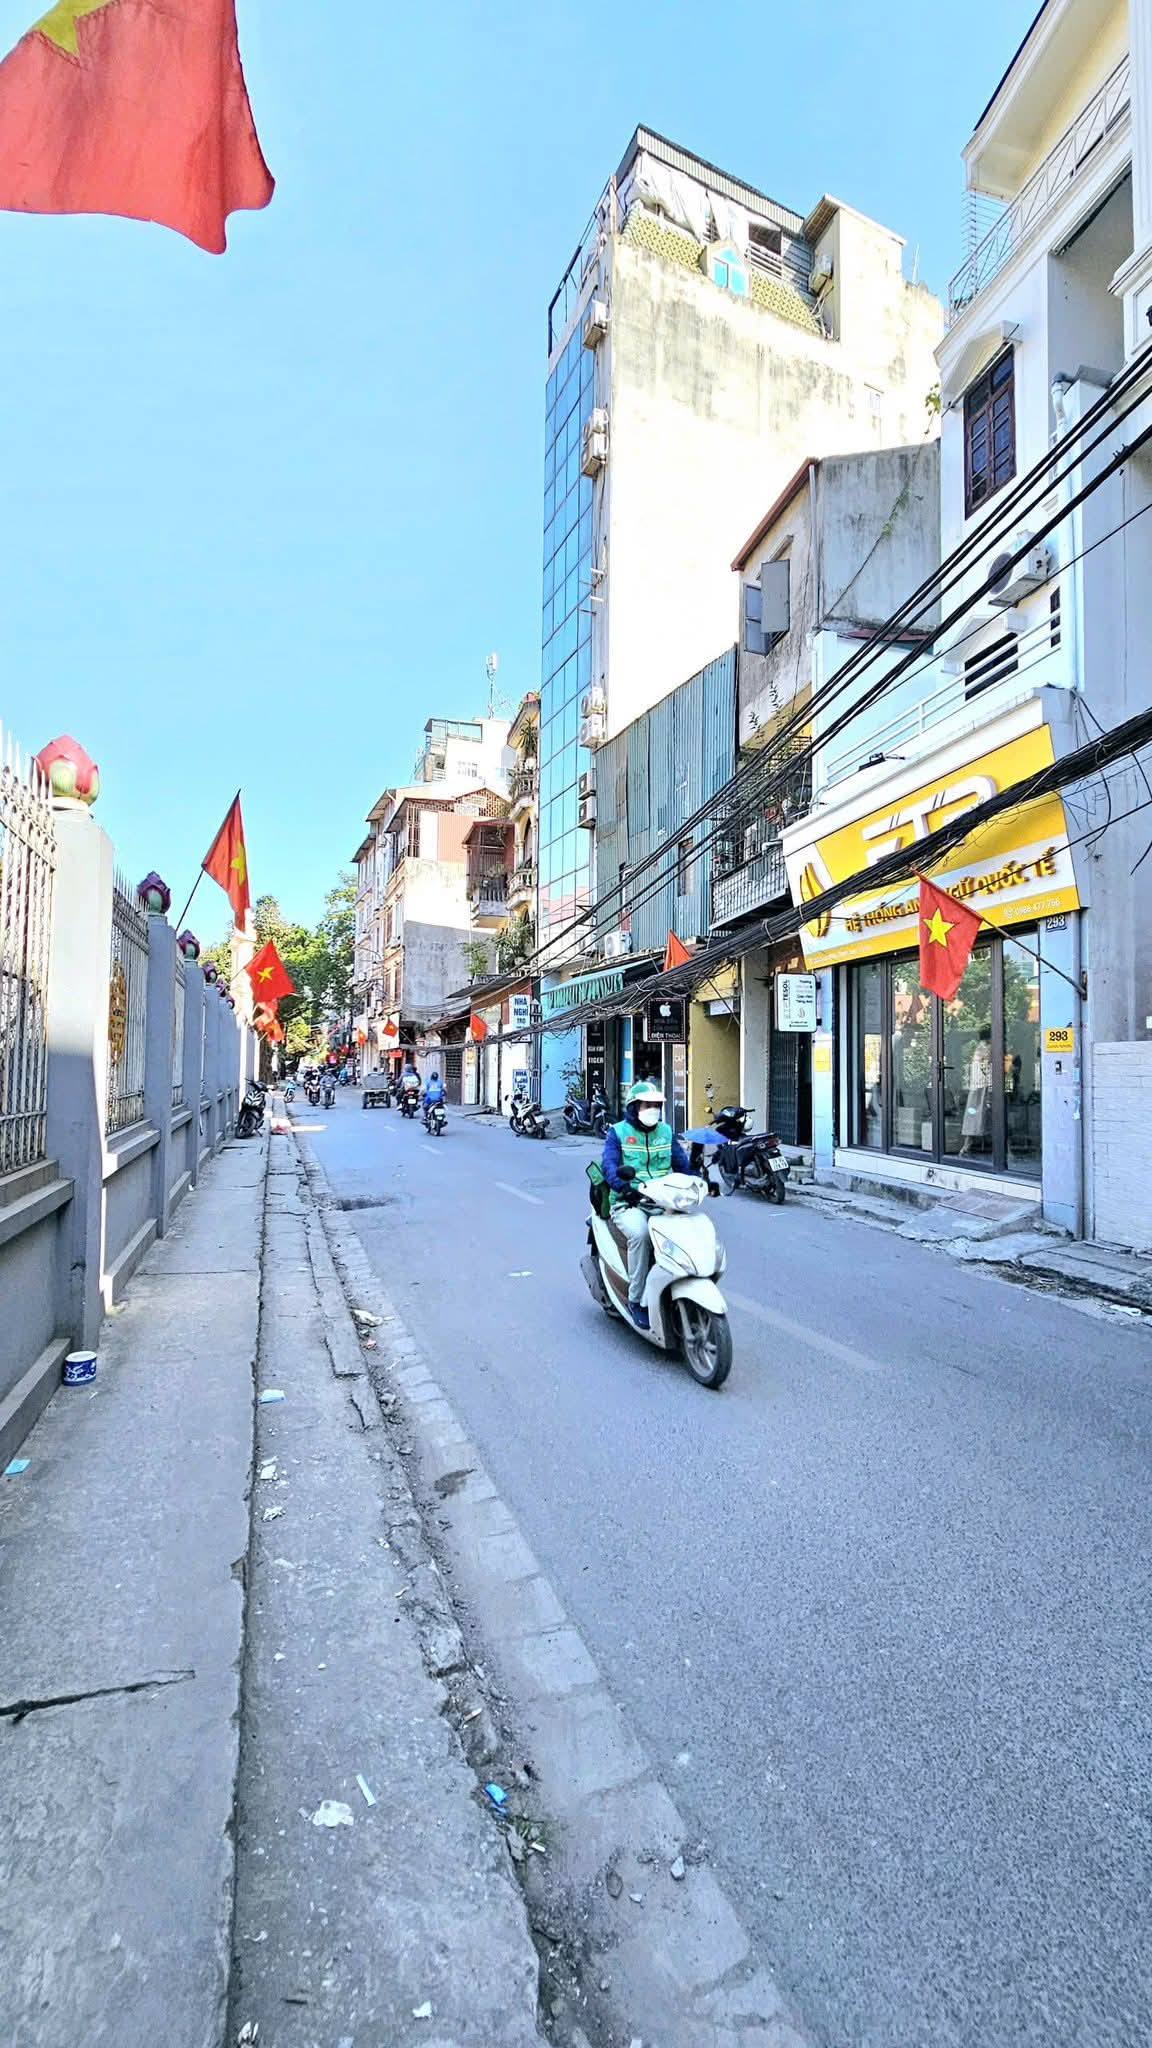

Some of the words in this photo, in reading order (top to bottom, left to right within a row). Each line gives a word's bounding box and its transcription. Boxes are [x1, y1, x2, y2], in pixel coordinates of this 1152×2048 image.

[864, 902, 901, 928] THỐNG
[904, 896, 920, 915] AN
[976, 860, 1027, 897] QUỐC
[1034, 846, 1057, 878] TẾ
[1046, 914, 1065, 929] 293
[1049, 1030, 1068, 1041] 293
